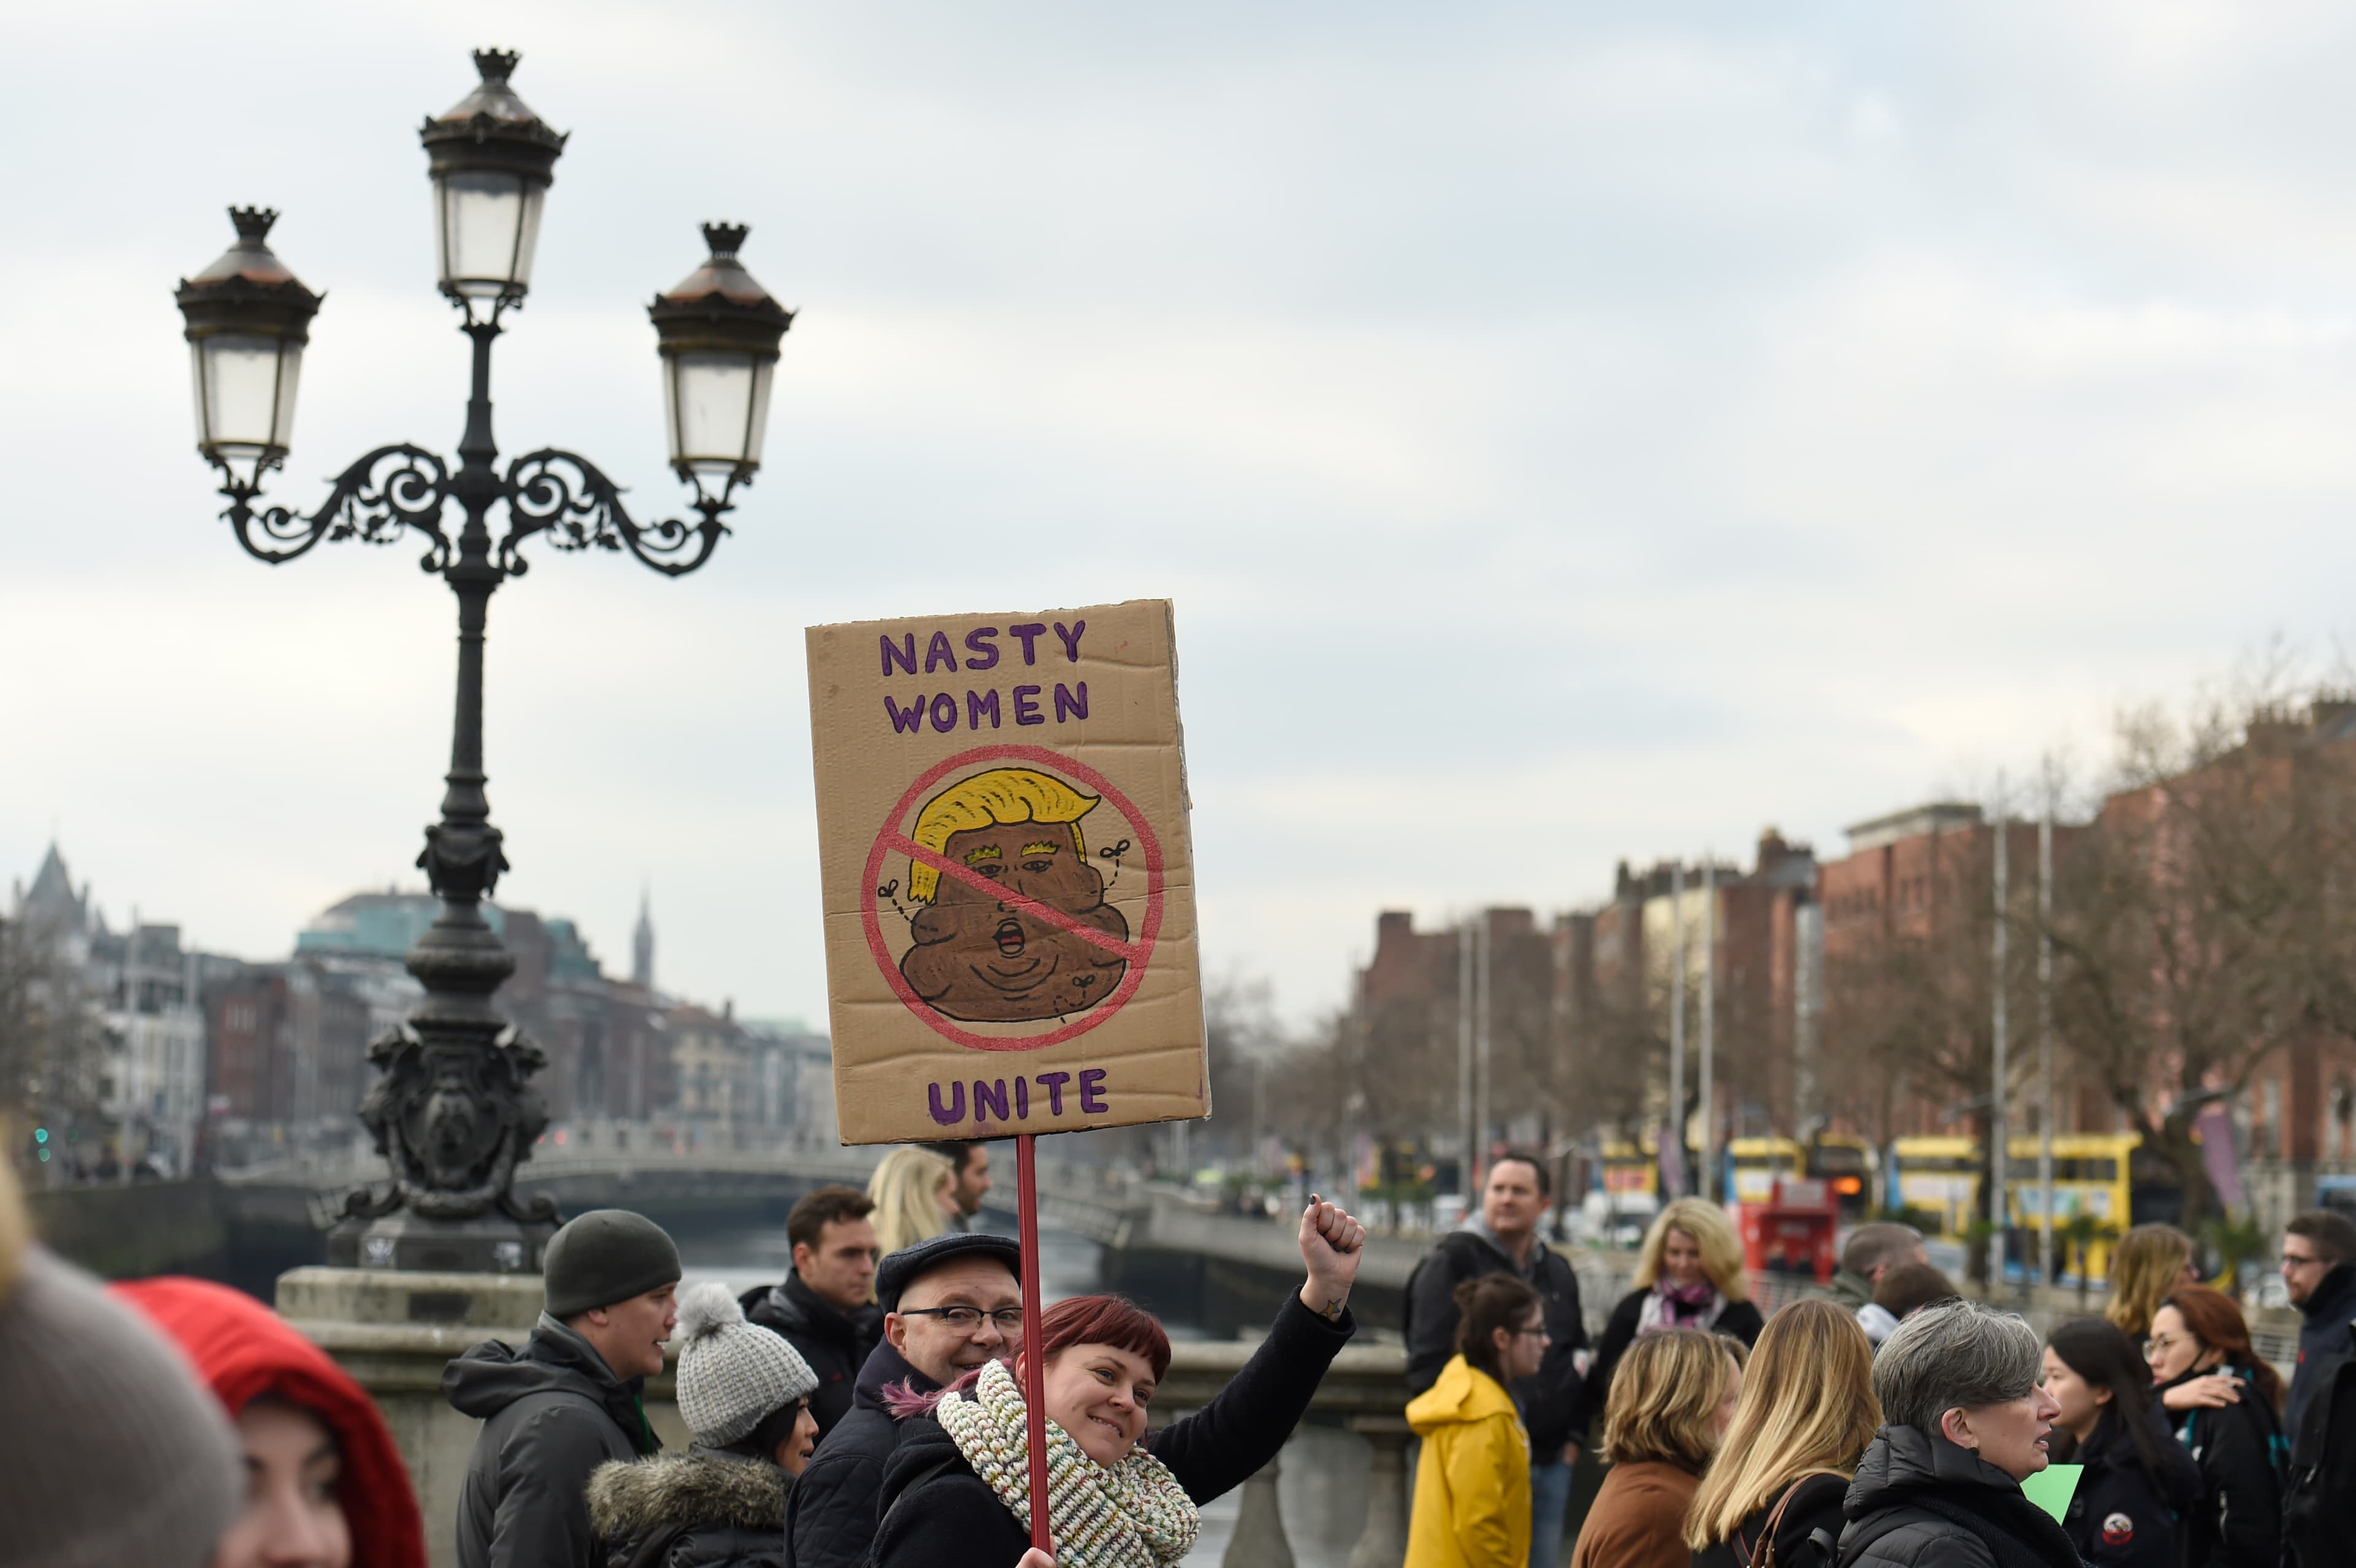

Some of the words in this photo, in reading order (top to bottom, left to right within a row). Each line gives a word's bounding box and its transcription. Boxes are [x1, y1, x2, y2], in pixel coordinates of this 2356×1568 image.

[879, 620, 1086, 677] NASTY
[884, 681, 1088, 734] WOMEN
[927, 1068, 1109, 1126] UNITE
